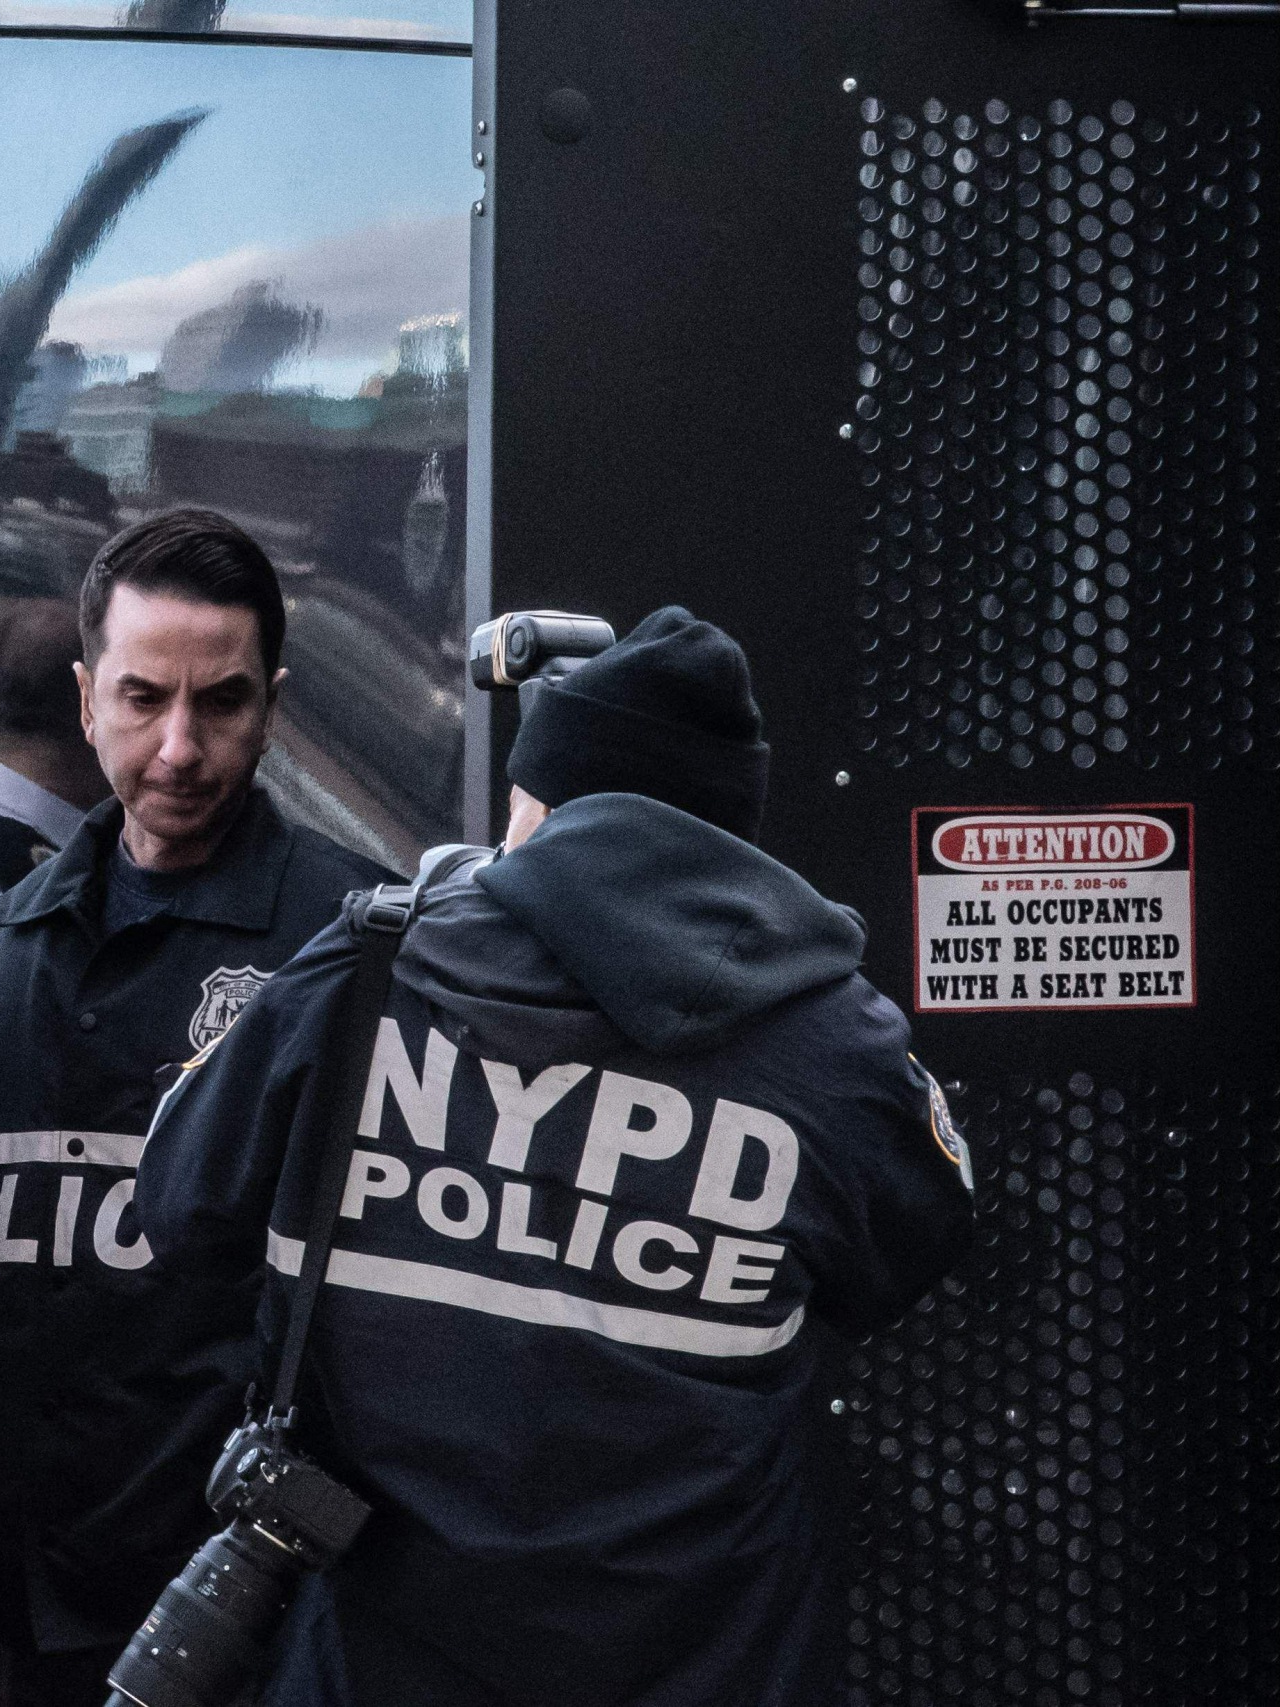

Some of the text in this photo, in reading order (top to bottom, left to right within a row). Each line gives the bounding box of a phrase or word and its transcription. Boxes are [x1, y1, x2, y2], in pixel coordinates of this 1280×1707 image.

[960, 825, 1148, 862] ATTENTION
[981, 880, 999, 892] AS
[1006, 879, 1034, 891] PER
[1073, 878, 1128, 891] 208-06
[946, 897, 1163, 926] ALL OCCUPANTS
[930, 934, 1180, 964] MUST BE SECURED
[229, 989, 254, 997] POLIC
[927, 970, 1185, 1001] WITH A SEAT BELT
[356, 1016, 800, 1232] NYPD
[339, 1149, 786, 1304] POLICE
